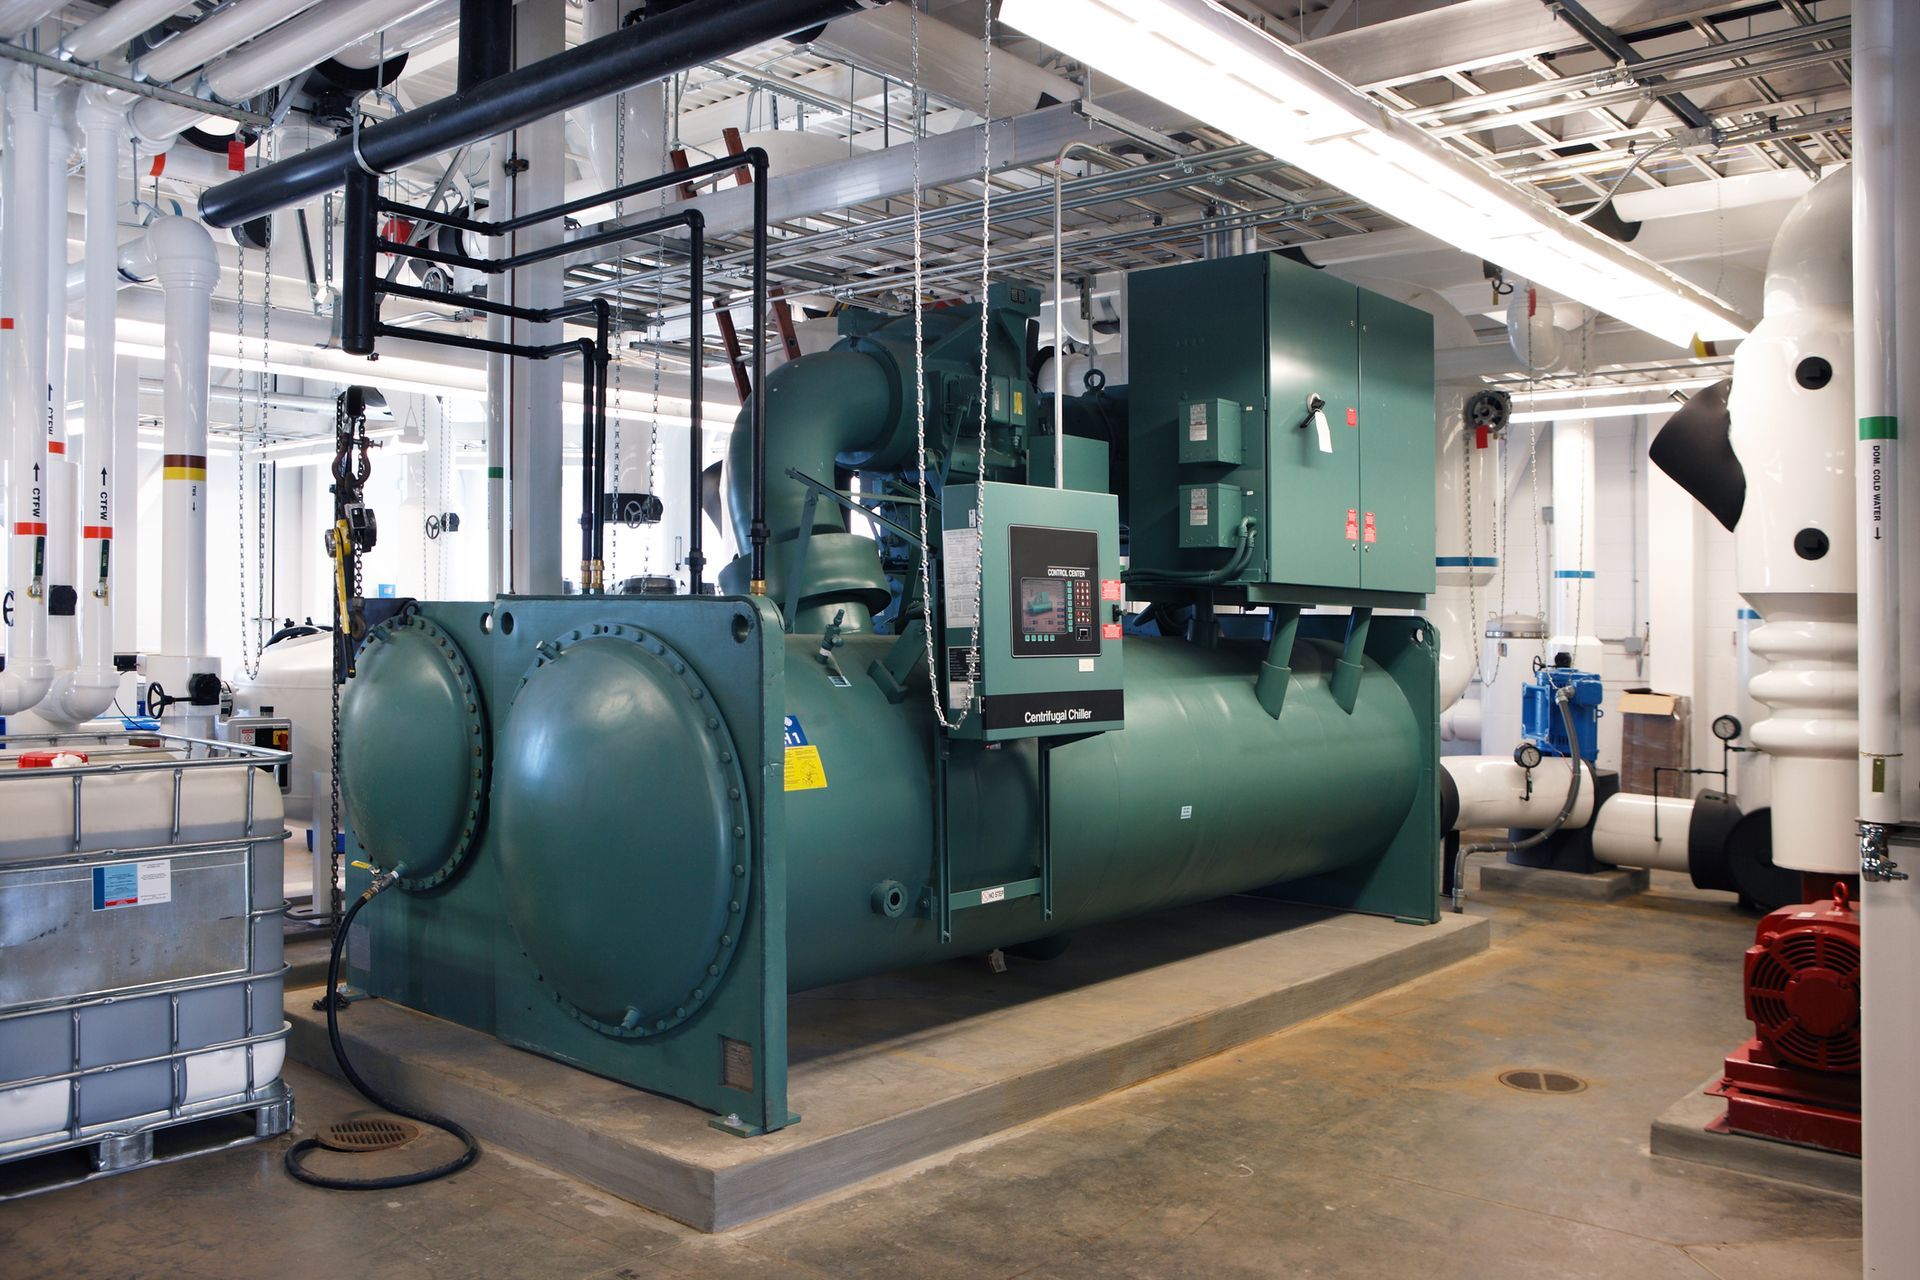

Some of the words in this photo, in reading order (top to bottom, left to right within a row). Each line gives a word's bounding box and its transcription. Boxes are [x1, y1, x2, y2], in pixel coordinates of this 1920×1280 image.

[1873, 445, 1881, 467] DOM.
[1873, 469, 1881, 491] COLD
[32, 487, 41, 518] CTFW
[100, 491, 108, 520] CTFW
[1873, 493, 1881, 522] WATER
[1047, 568, 1069, 577] CONTROL
[1068, 569, 1086, 578] CENTER
[1024, 709, 1067, 724] Centrifugal
[1068, 708, 1092, 720] Chiller
